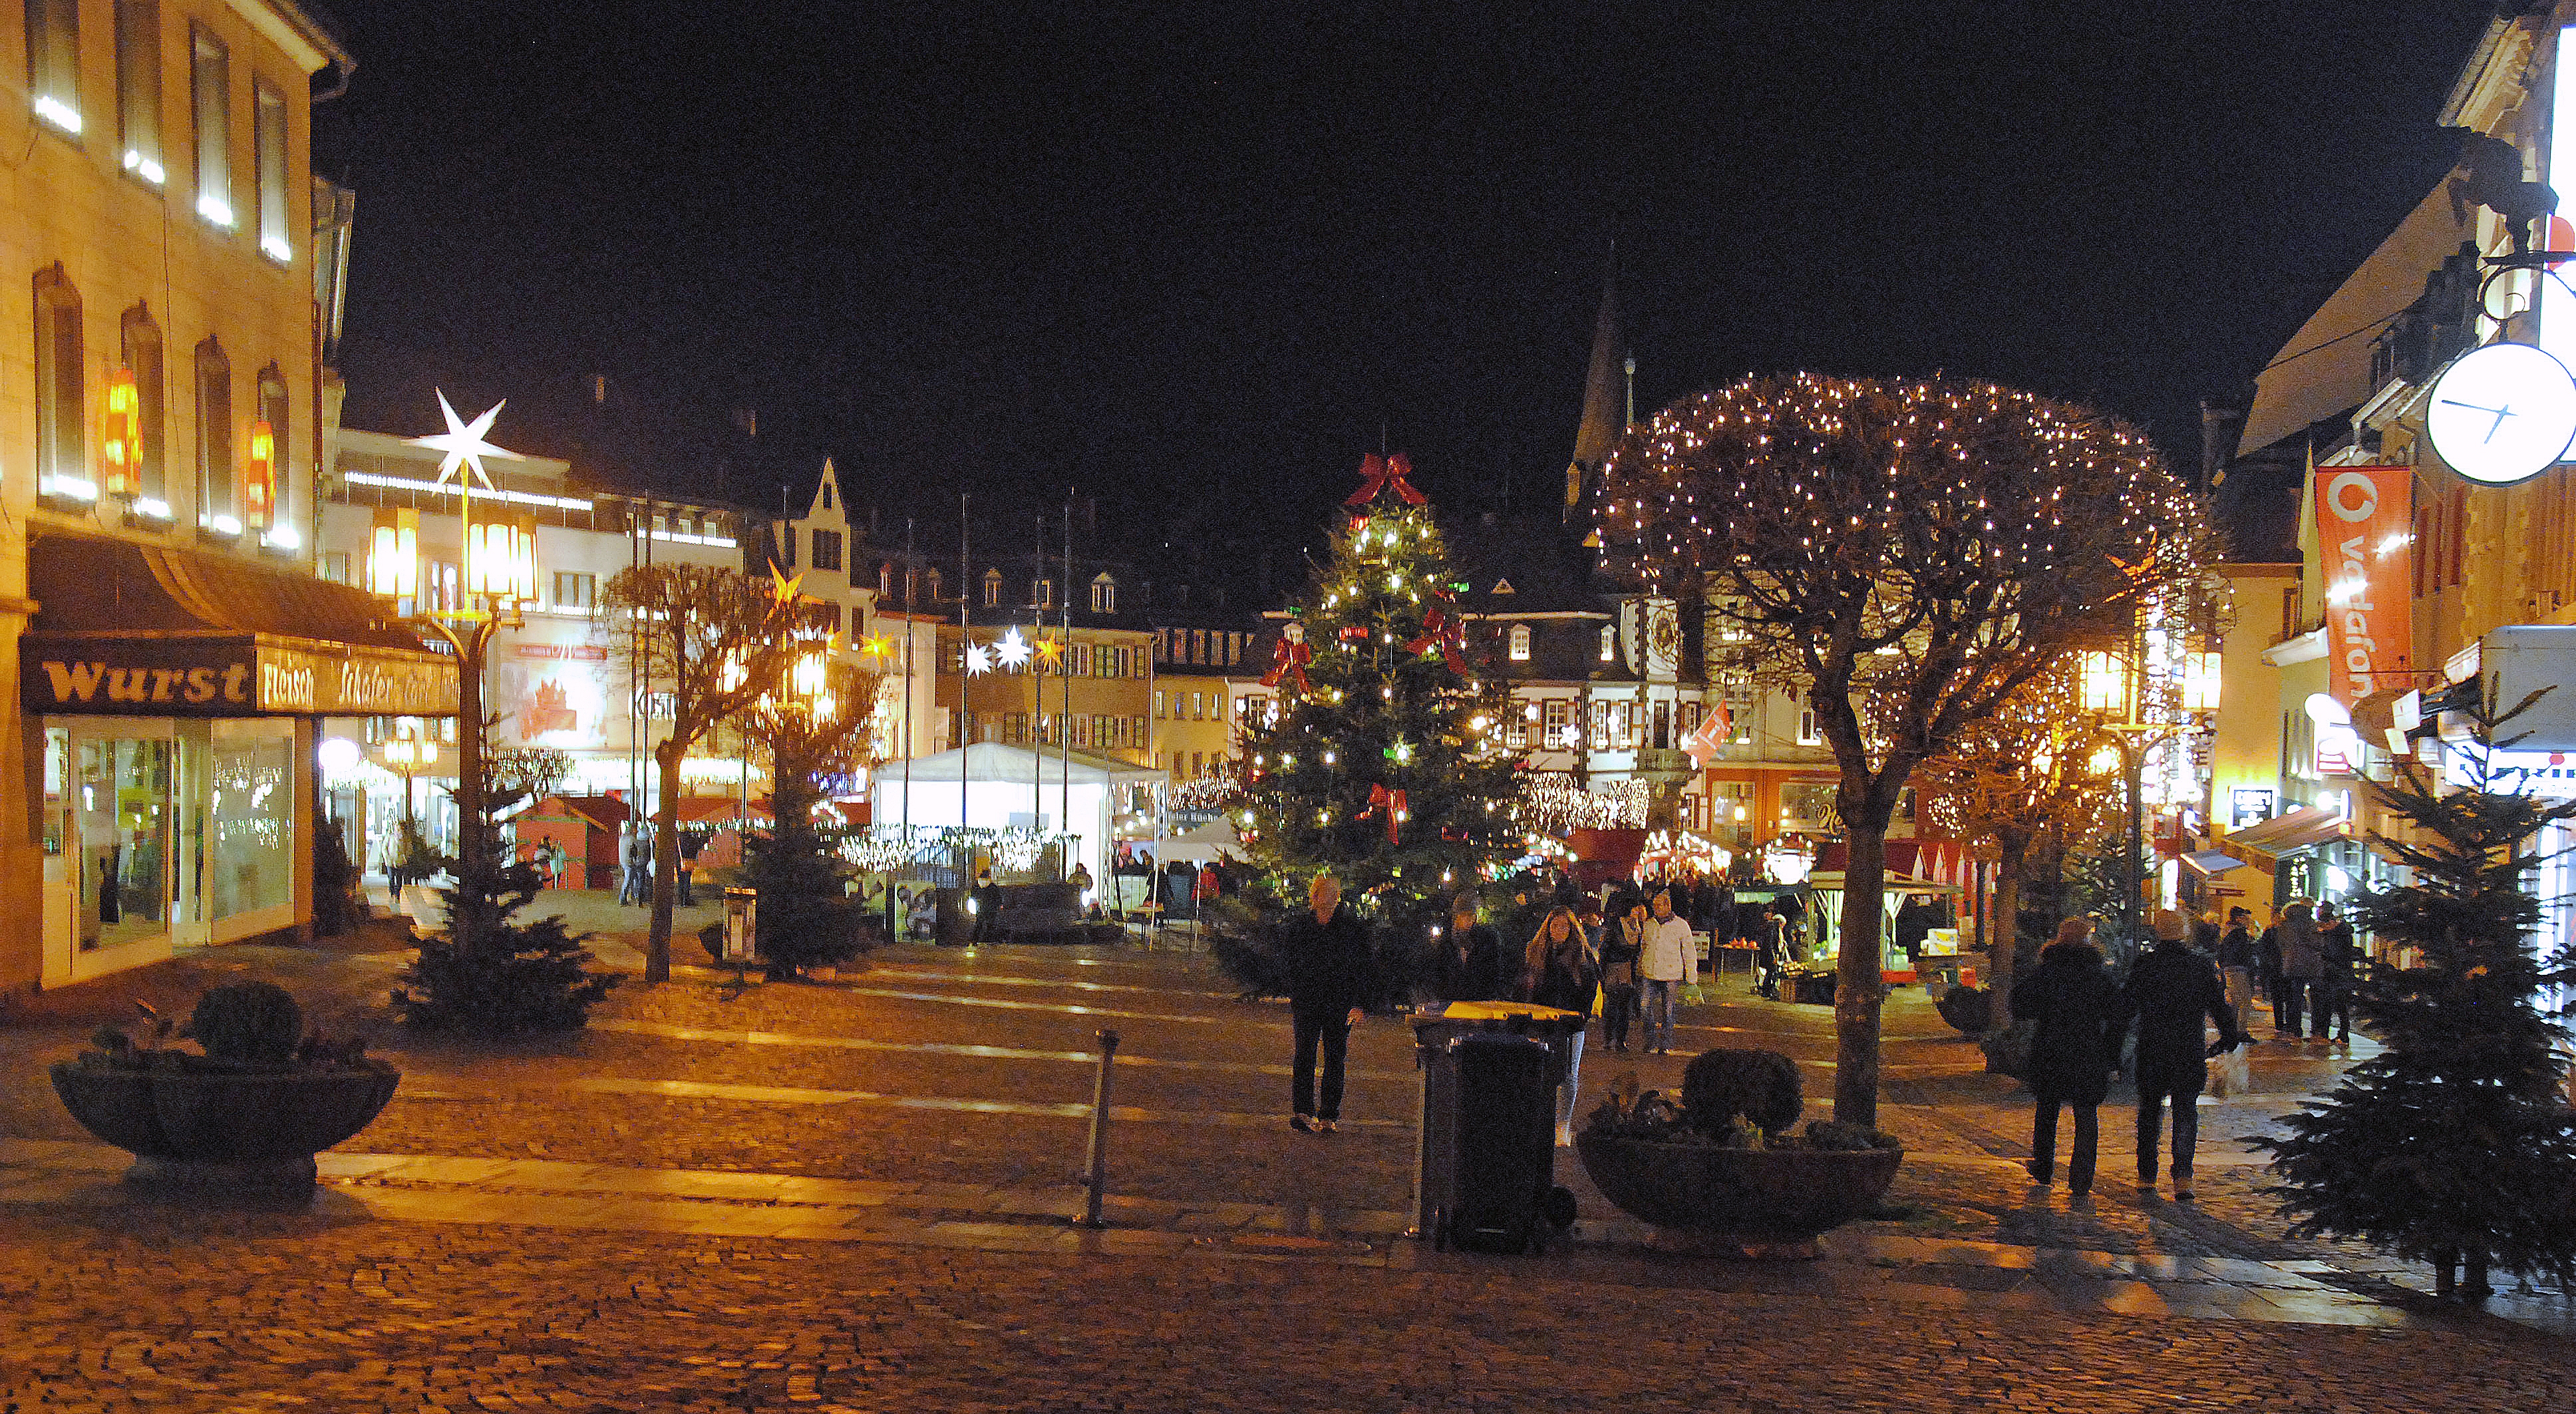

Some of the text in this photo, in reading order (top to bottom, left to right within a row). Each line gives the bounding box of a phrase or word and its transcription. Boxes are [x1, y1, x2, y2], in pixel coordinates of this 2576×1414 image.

[2340, 536, 2376, 709] vodafon
[43, 661, 249, 703] Wurst
[263, 663, 314, 707] Fleisch
